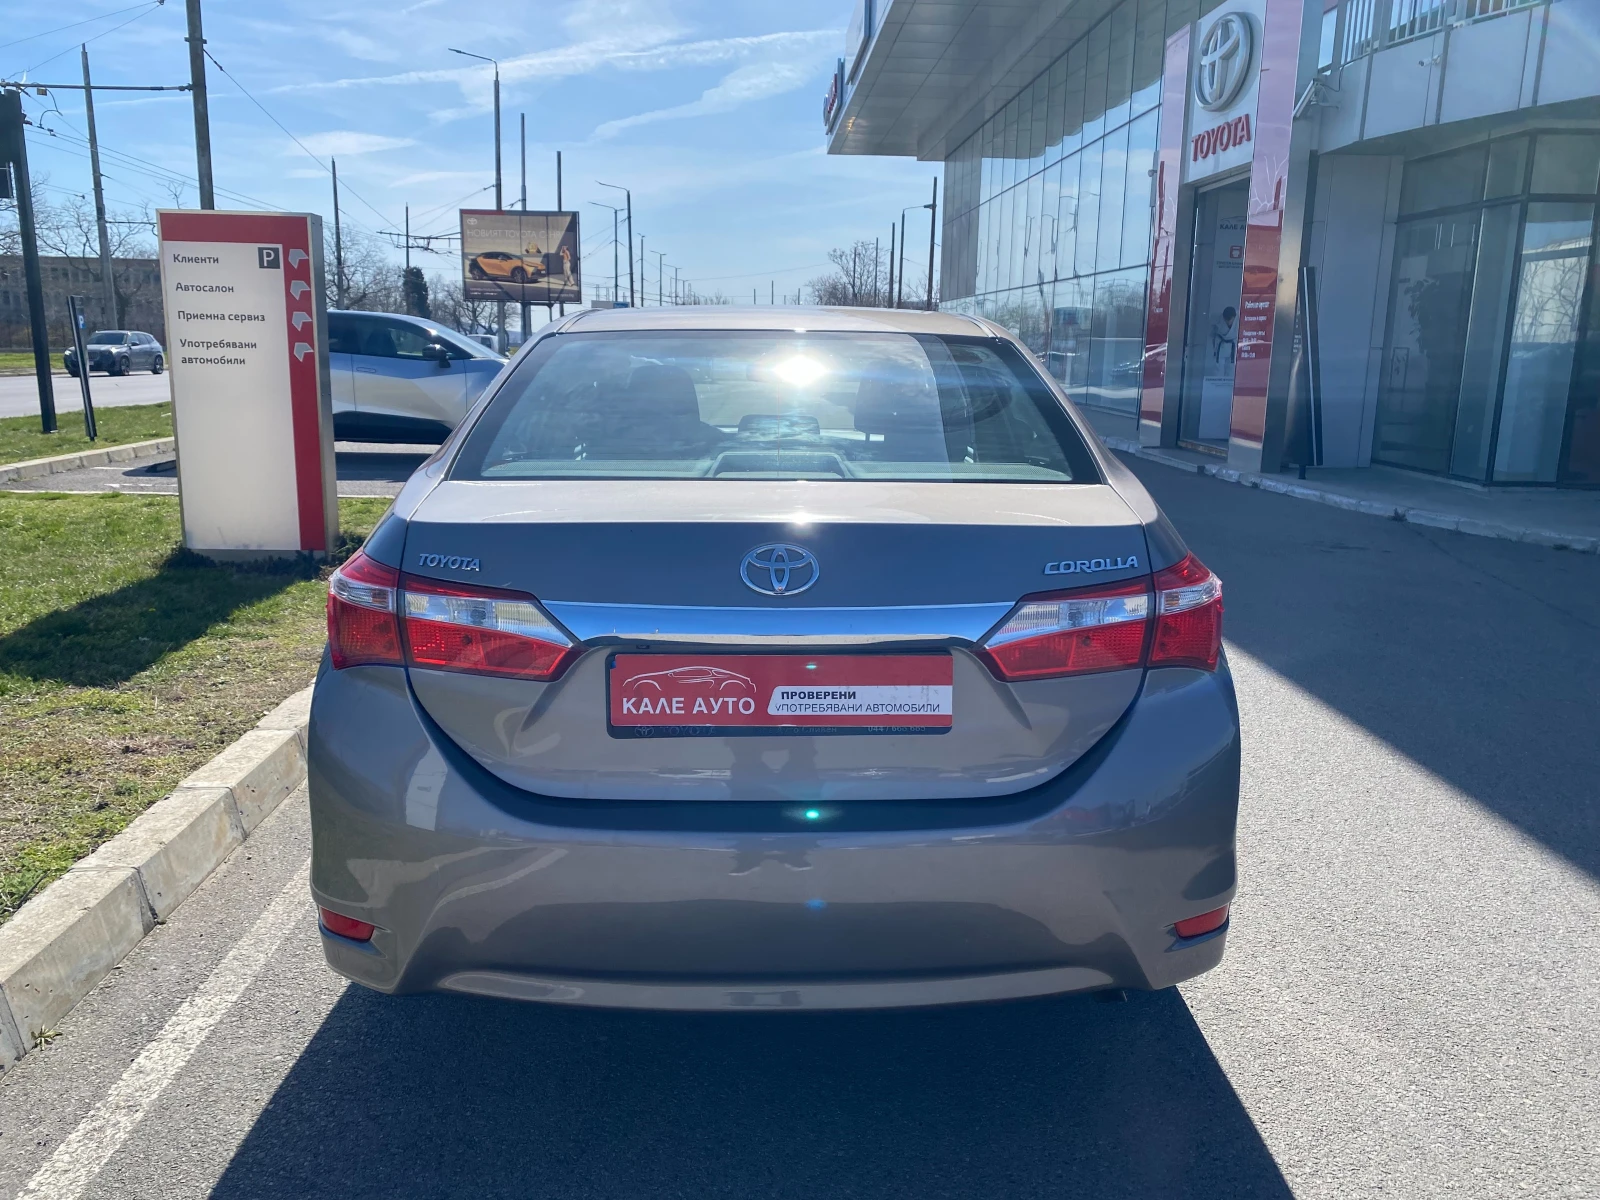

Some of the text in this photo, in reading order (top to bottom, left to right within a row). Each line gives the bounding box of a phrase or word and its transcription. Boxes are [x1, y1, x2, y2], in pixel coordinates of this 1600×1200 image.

[1191, 113, 1251, 162] TOYOTA
[467, 229, 502, 238] НОВИЯТ
[505, 230, 536, 239] TOYOTA
[173, 254, 219, 264] Клиенти
[263, 250, 275, 267] P
[175, 282, 234, 293] Автосалон
[177, 310, 265, 323] Приемна сервиз
[179, 338, 257, 350] Употребявани
[181, 354, 246, 365] автомобили
[419, 553, 480, 571] TOYOTA
[1044, 555, 1138, 575] COROLLA
[781, 691, 856, 700] ПРОВЕРЕНИ
[622, 697, 756, 714] КАЛЕ АУТО
[775, 703, 940, 713] УПОТРЕБЯВАНИ АВТОМОБИЛИ
